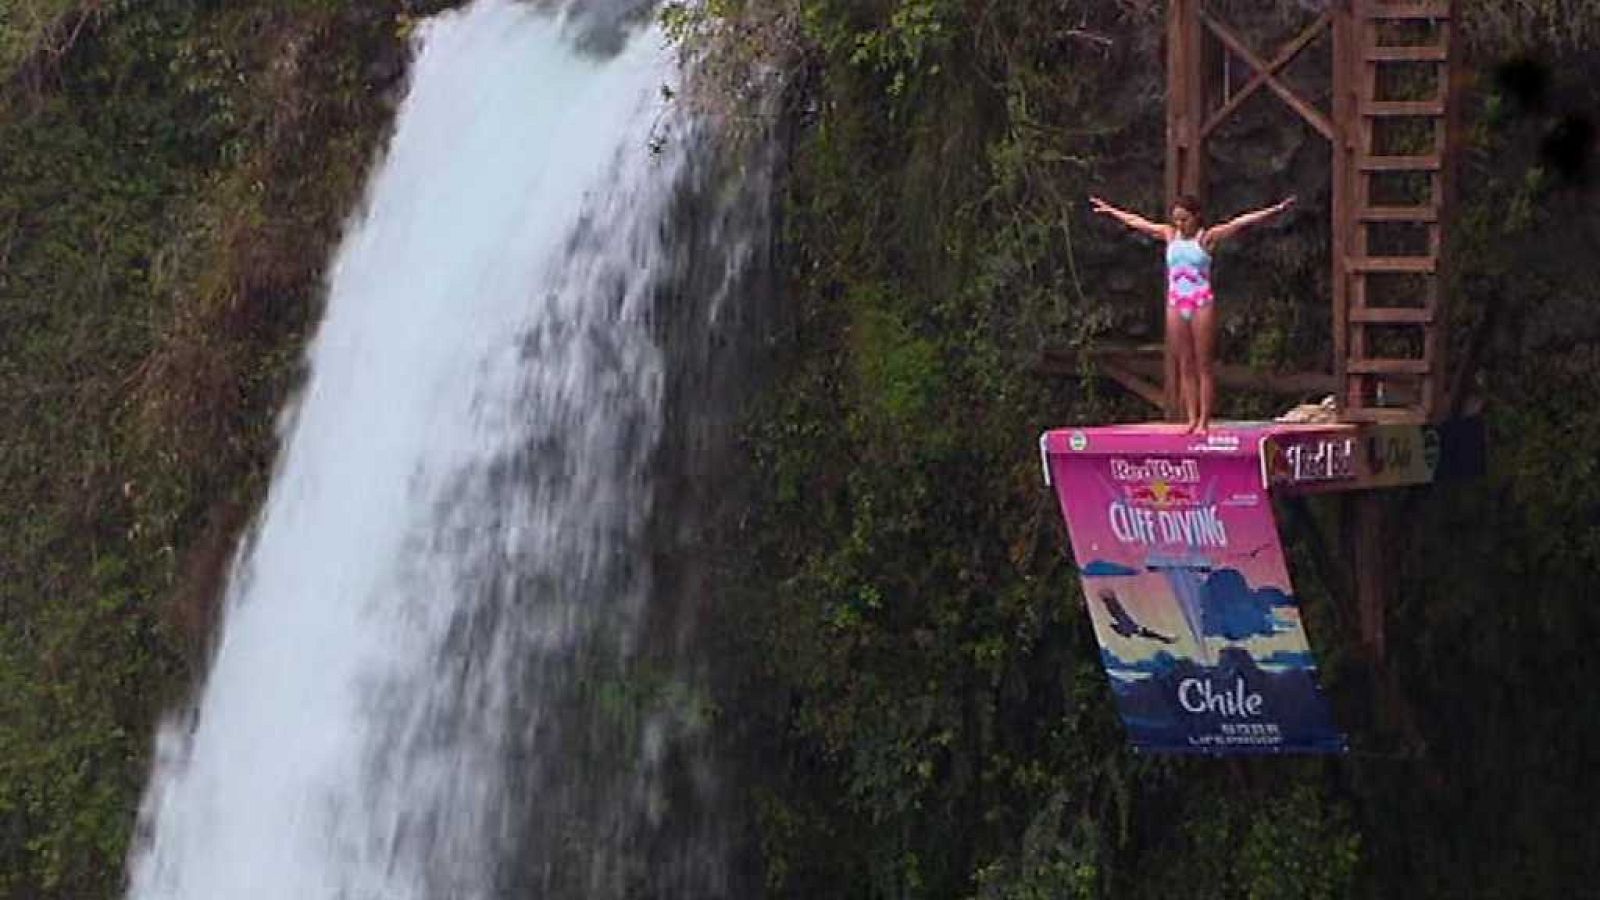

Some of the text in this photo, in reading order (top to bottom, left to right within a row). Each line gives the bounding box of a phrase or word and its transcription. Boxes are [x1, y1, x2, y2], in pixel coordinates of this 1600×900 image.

[1110, 501, 1227, 548] CLIFF DIVING
[1178, 676, 1264, 718] Chile
